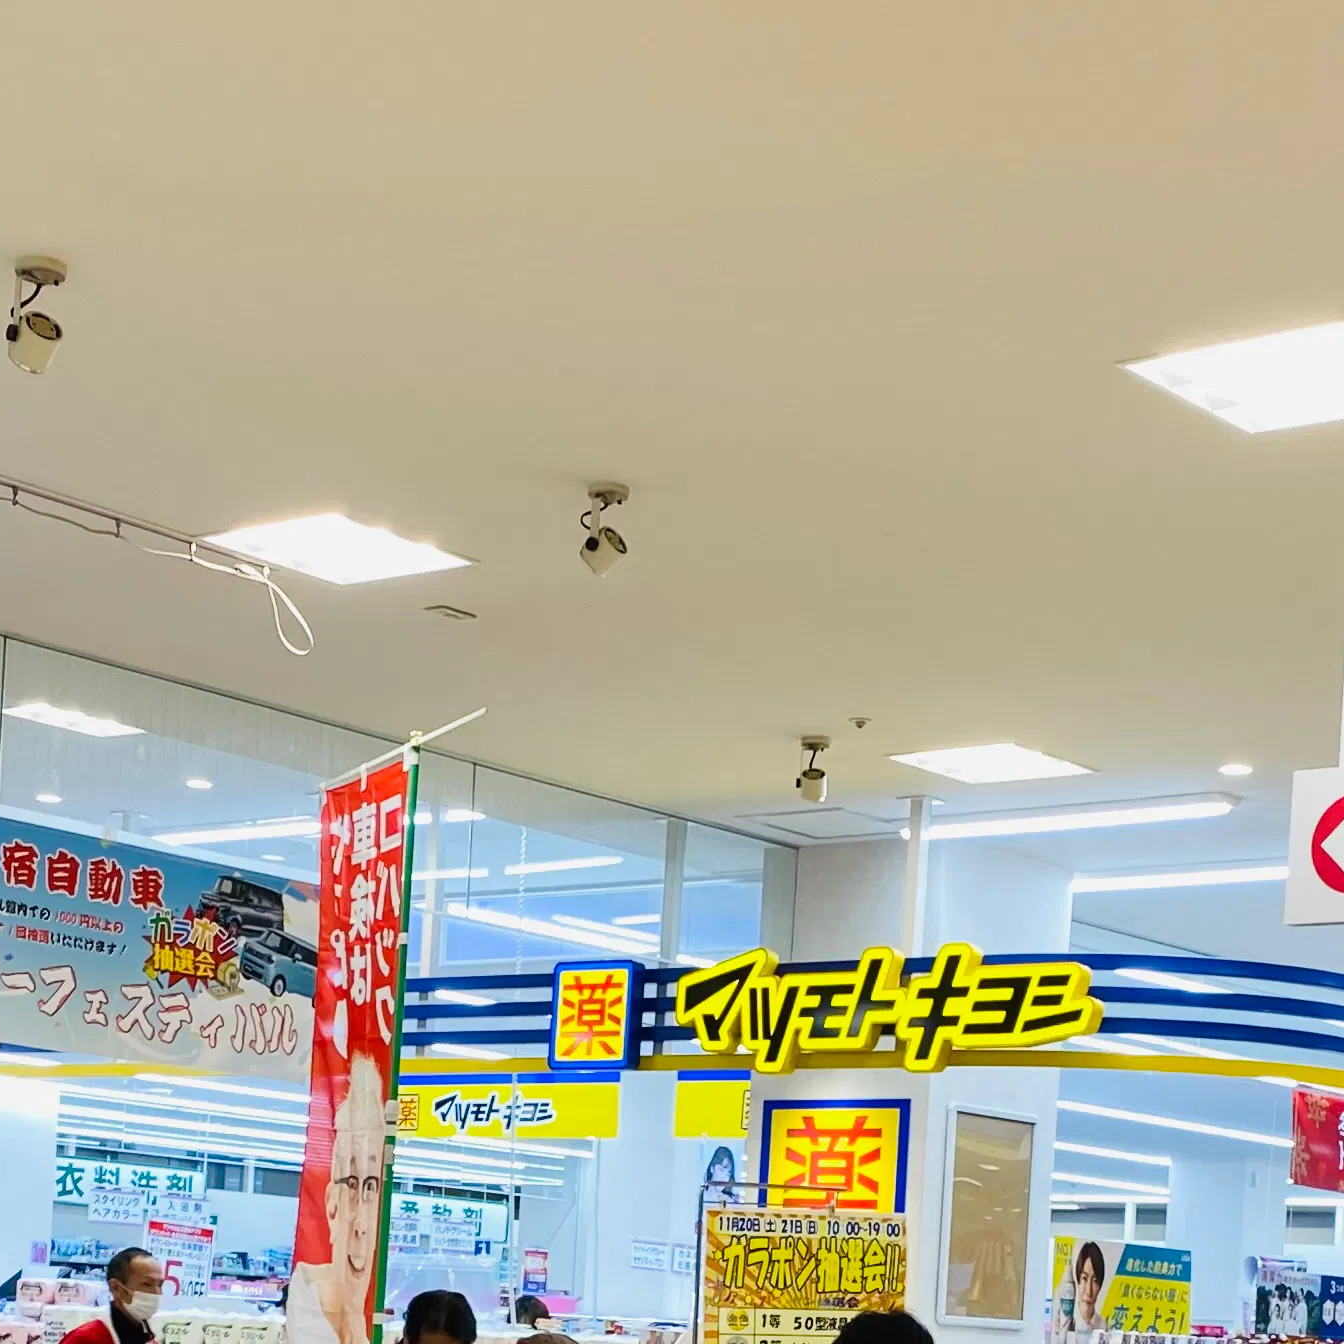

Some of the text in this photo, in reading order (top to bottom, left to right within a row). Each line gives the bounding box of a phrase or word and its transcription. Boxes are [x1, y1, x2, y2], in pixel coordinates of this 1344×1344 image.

[149, 914, 237, 956] ガラポン
[154, 945, 216, 978] 抽選会
[560, 974, 625, 1057] 薬
[679, 948, 1099, 1070] マツモトキヨシ
[397, 1097, 419, 1127] 薬
[434, 1093, 553, 1130] マツモトキヨシ
[93, 1207, 141, 1220] ヘアカラー
[761, 1314, 781, 1328] 1等
